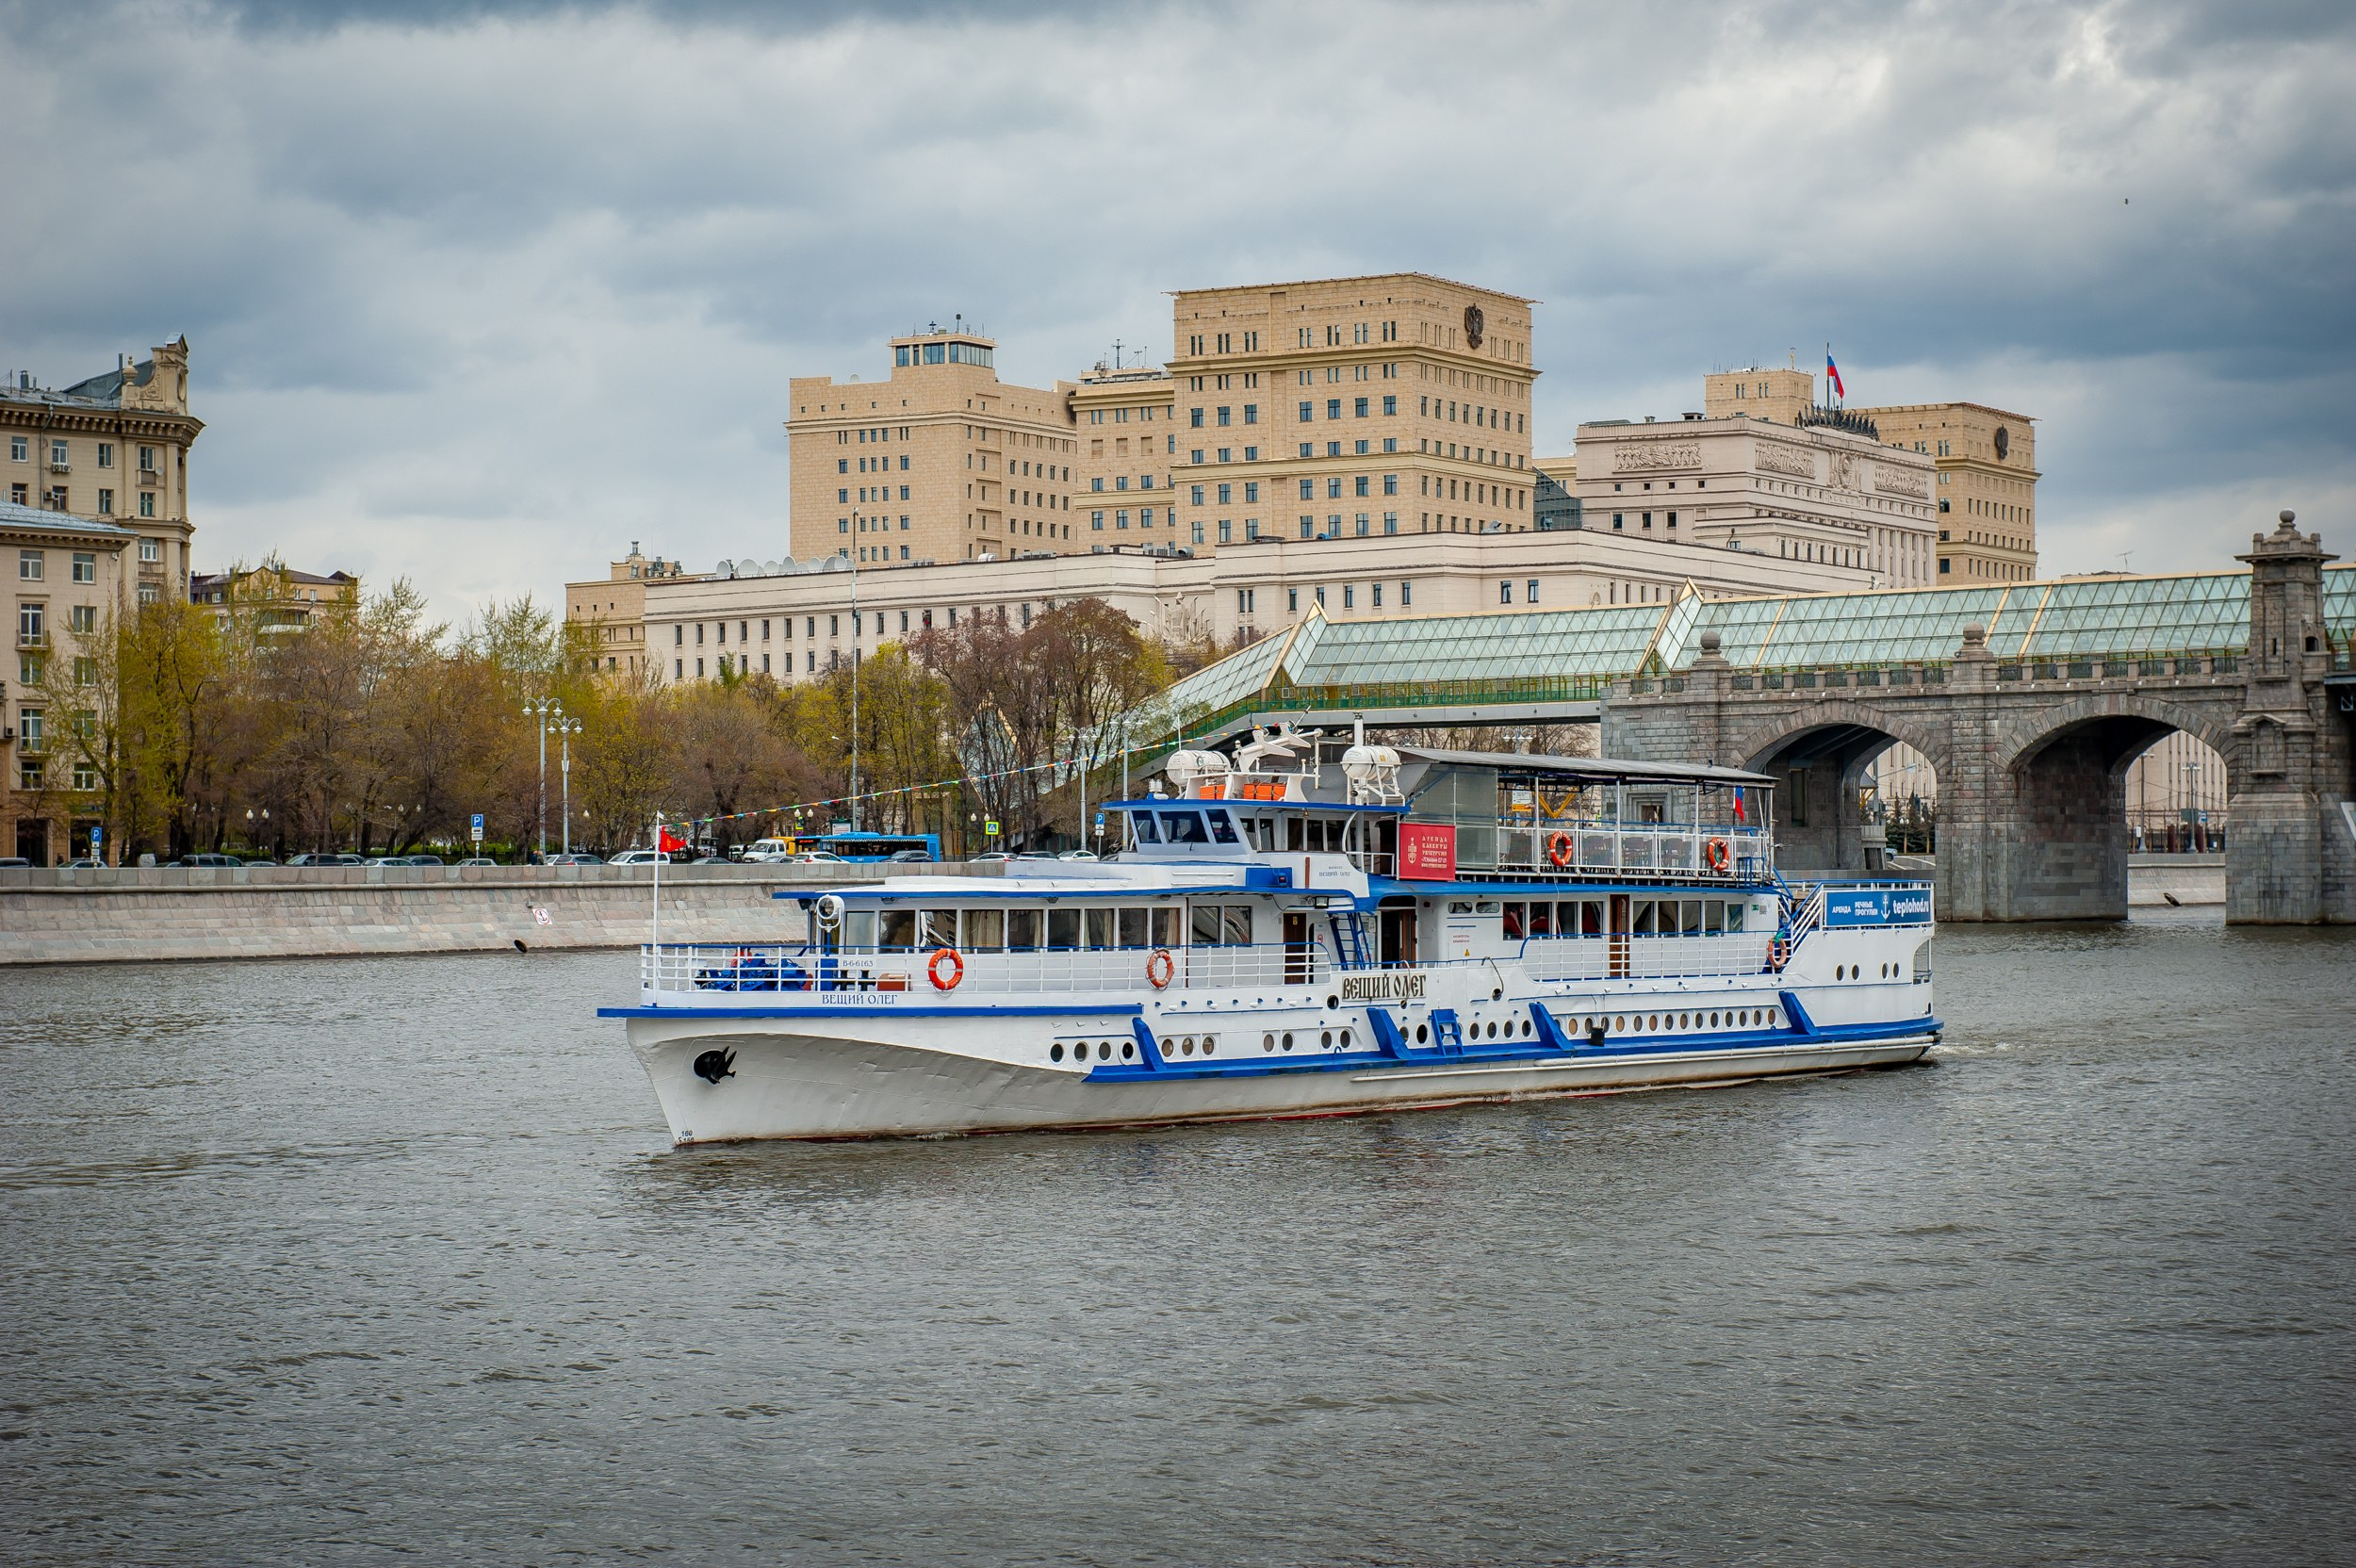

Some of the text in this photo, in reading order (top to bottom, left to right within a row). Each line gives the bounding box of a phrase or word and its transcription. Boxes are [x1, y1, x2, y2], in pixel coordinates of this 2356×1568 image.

[473, 816, 481, 826] P
[1097, 814, 1104, 824] P
[93, 829, 100, 840] P
[1832, 906, 1851, 914] АРЕНДА
[1893, 897, 1929, 918] teplohod.ru
[1343, 972, 1426, 1002] ВЕЩИЙ ОЛЕГ
[822, 993, 897, 1005] ВЕЩИЙ ОЛЕГ
